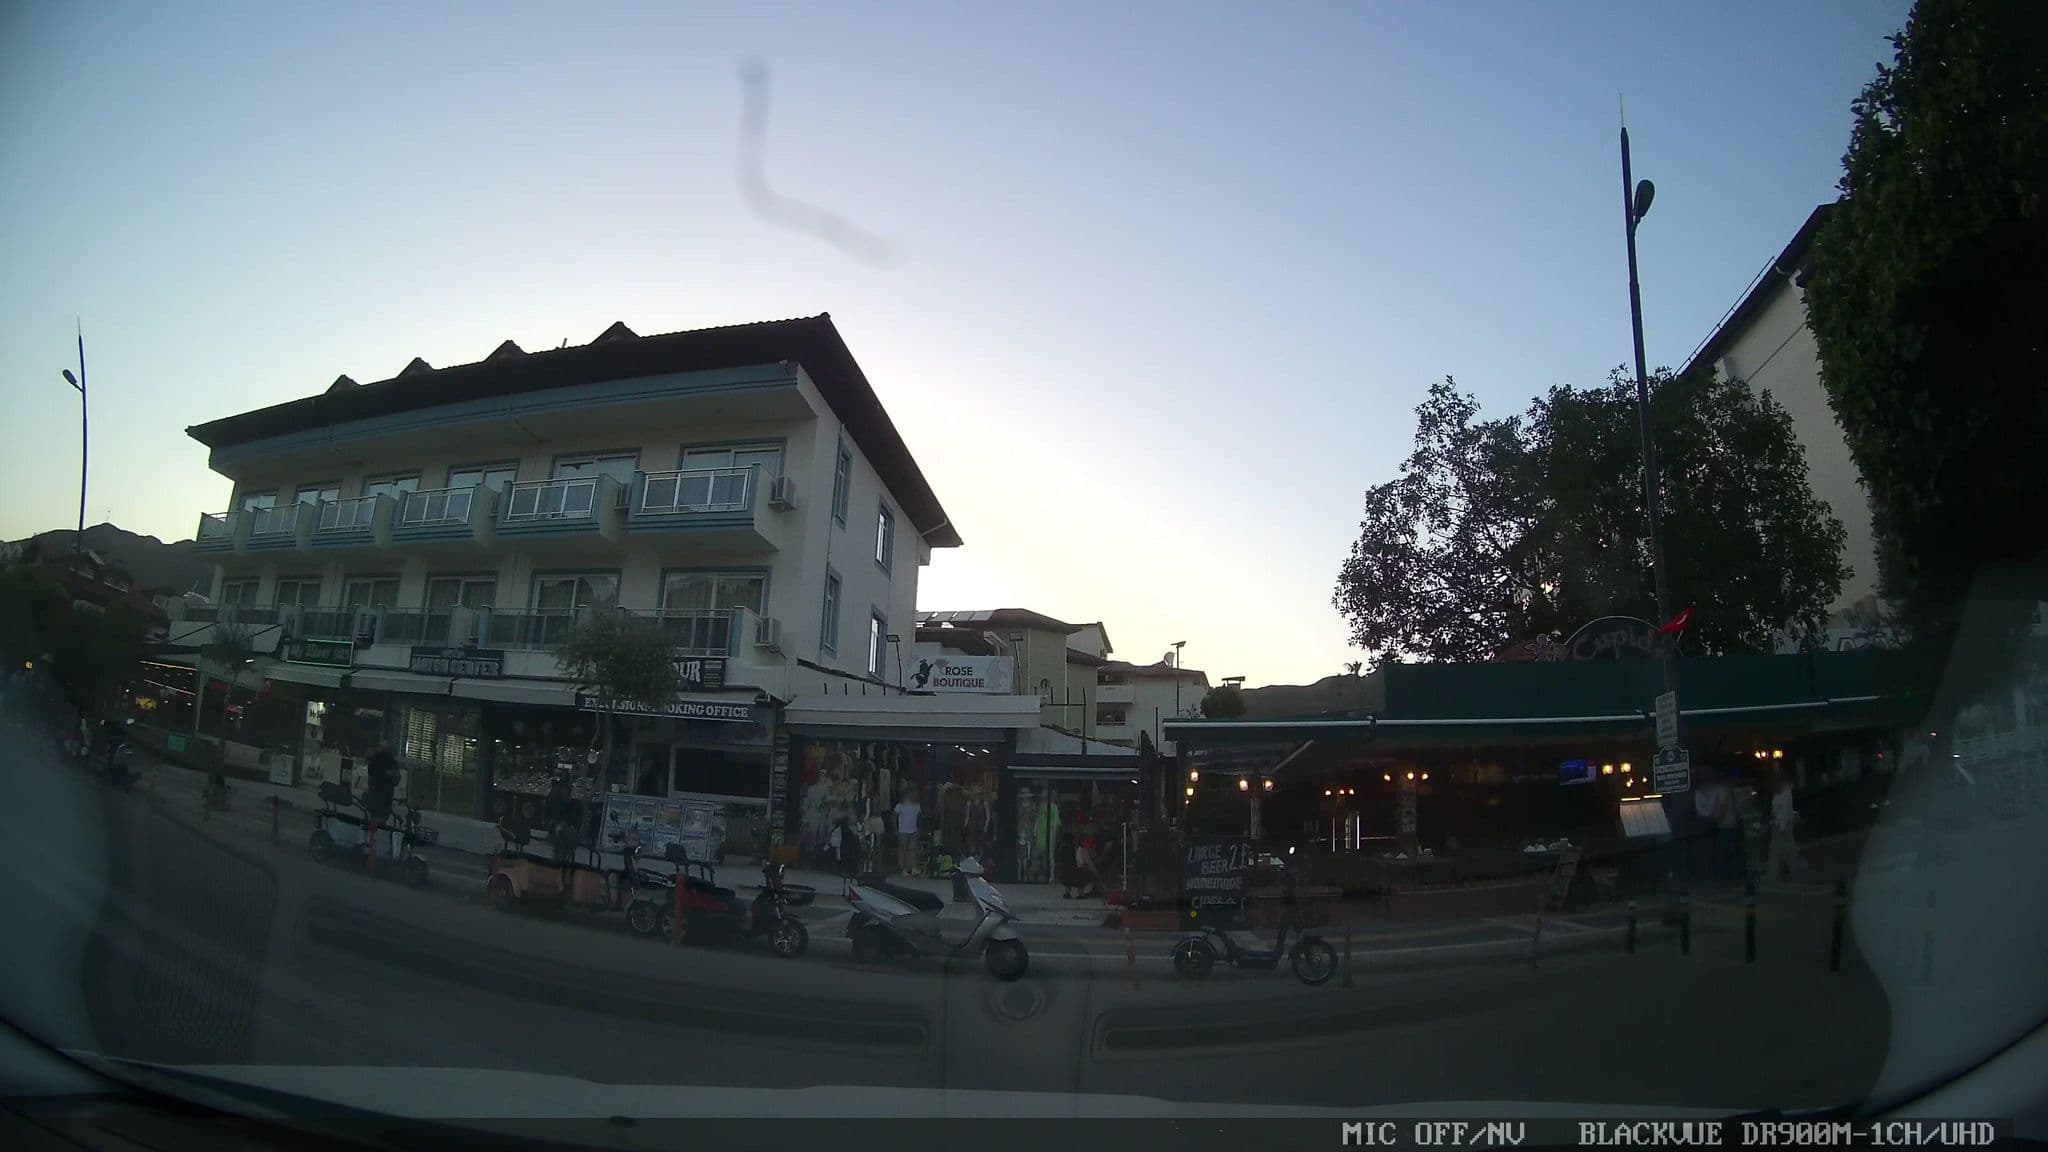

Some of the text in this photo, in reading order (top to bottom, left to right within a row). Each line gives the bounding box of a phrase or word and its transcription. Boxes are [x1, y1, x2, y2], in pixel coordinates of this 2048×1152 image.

[945, 666, 974, 676] ROSE
[933, 678, 985, 688] BOUTIQUE
[706, 705, 749, 718] OFFICE
[1200, 858, 1229, 875] BEER
